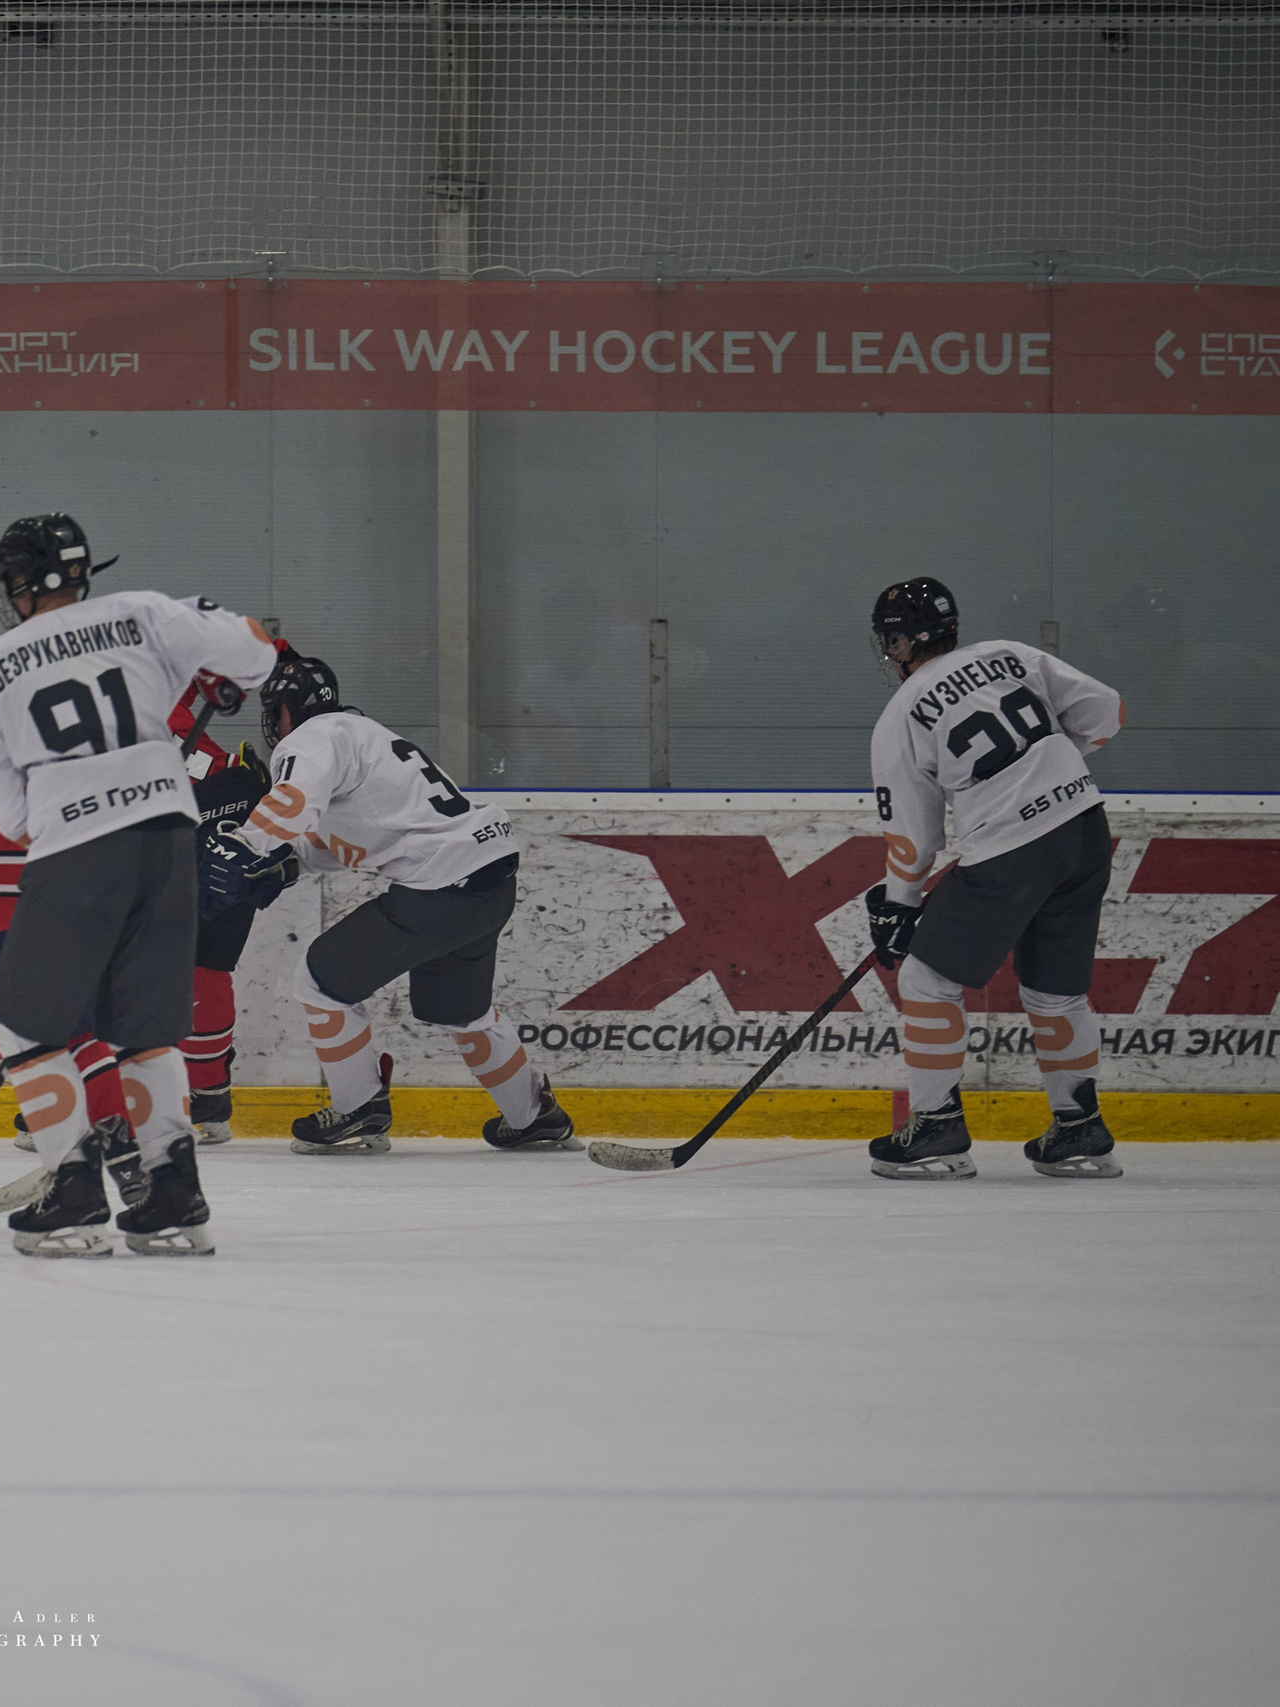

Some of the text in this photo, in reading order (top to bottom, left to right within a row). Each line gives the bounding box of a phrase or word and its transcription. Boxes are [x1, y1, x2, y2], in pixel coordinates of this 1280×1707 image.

[249, 328, 1051, 375] SILK WAY HOCKEY LEAGUE
[29, 666, 137, 754] 91
[910, 655, 1027, 731] КУЗНЕЦОВ
[200, 800, 248, 822] AUER
[206, 835, 238, 861] CM
[518, 1023, 901, 1053] РОФЕССИОНАЛЬНА
